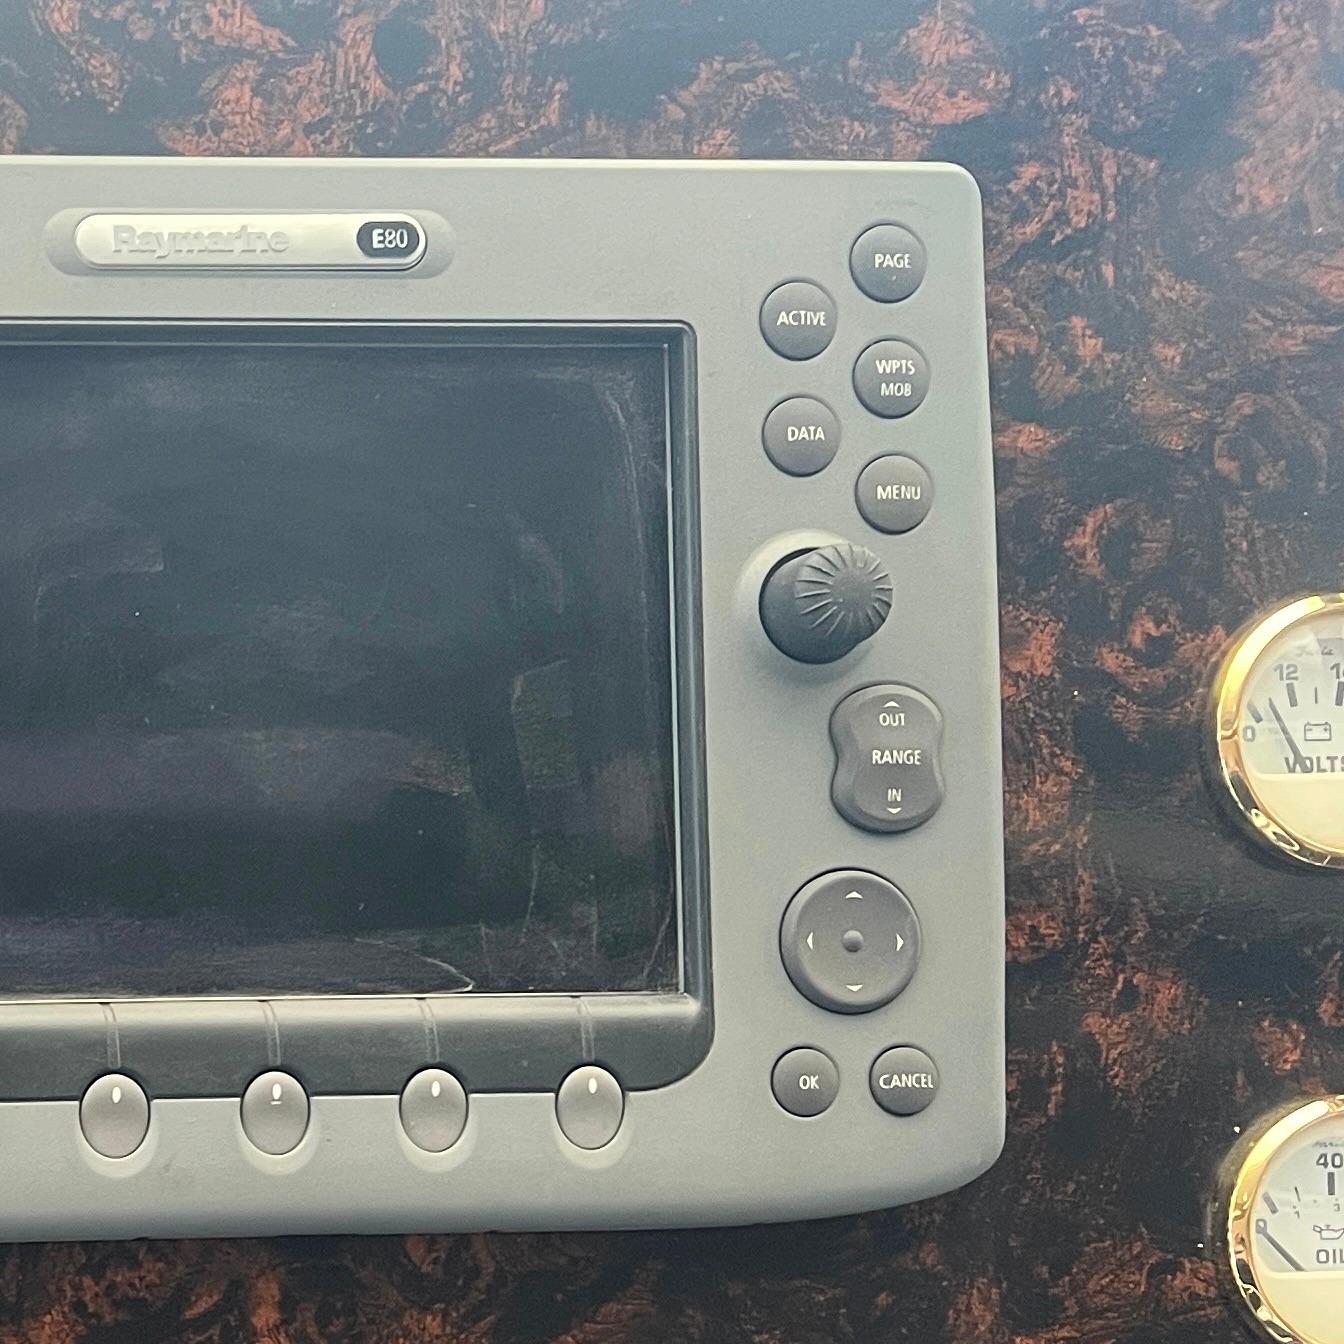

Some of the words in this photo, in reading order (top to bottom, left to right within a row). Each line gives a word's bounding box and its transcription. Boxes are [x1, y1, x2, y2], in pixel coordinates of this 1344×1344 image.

[113, 225, 290, 259] Raymarine
[372, 228, 408, 249] E80
[874, 253, 912, 269] PAGE
[777, 310, 827, 326] ACTIVE
[876, 359, 915, 375] WPTS
[880, 382, 912, 397] MOB
[787, 426, 825, 442] DATA
[876, 485, 921, 500] MENU
[1274, 664, 1299, 681] 12
[1330, 663, 1344, 681] 1
[879, 712, 905, 727] OUT
[871, 749, 921, 766] RANGE
[887, 788, 902, 803] IN
[798, 1075, 819, 1091] OK
[879, 1073, 934, 1090] CANCEL
[1316, 1152, 1344, 1170] 40
